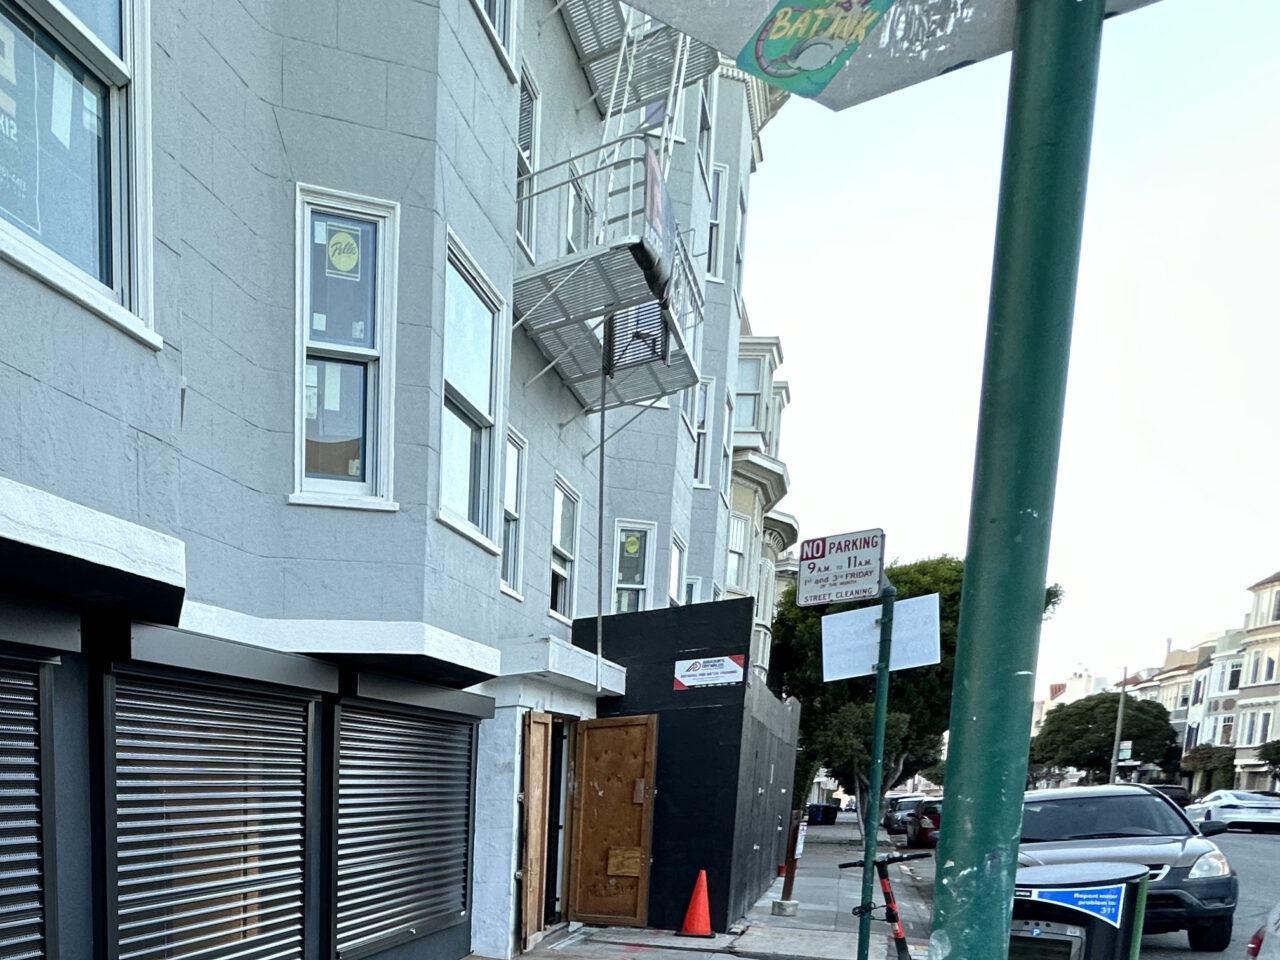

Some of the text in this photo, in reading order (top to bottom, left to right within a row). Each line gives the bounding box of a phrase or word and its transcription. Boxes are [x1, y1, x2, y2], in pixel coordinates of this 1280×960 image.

[769, 7, 827, 40] BAT
[330, 240, 357, 258] Pella
[802, 535, 879, 559] NO PARKING
[807, 562, 816, 574] 9
[847, 555, 857, 569] 11
[814, 576, 829, 585] and
[845, 569, 874, 580] FRIDAY
[804, 587, 873, 603] STREET CLEANING
[1100, 906, 1116, 914] 311
